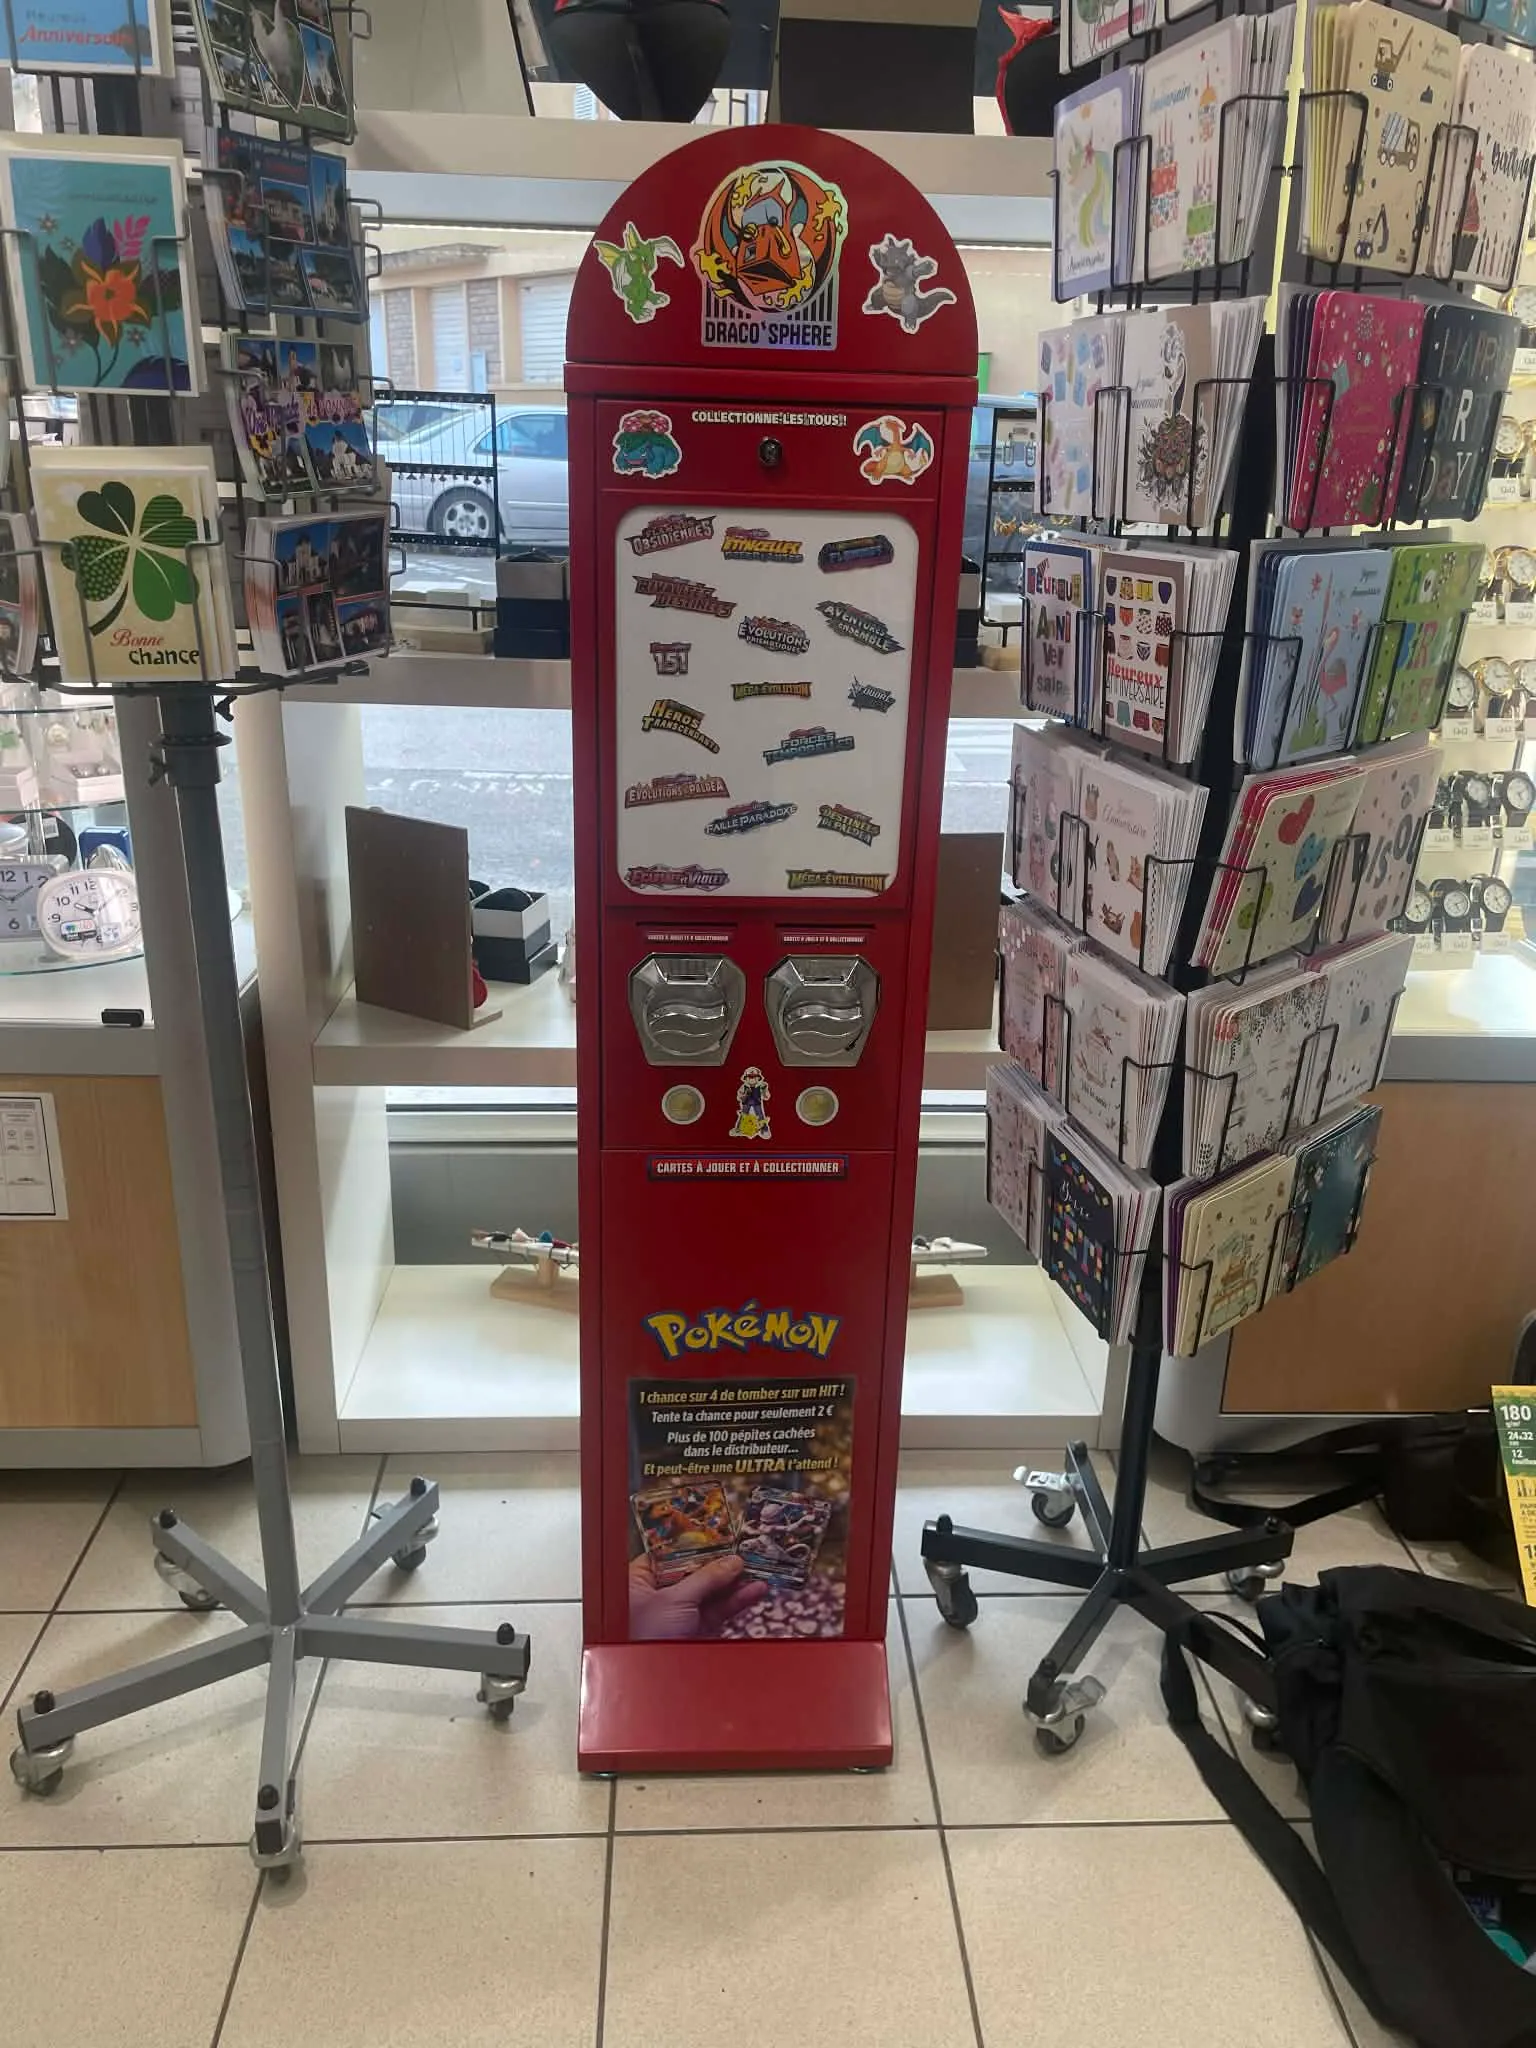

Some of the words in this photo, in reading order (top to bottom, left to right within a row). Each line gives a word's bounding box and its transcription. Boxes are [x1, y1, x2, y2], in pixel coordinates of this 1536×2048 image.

[692, 411, 804, 425] COLLECTIONNE-LES
[110, 629, 164, 647] Bonne
[129, 648, 200, 666] chance
[655, 652, 689, 675] 151
[1107, 656, 1163, 687] Heureux
[656, 1162, 693, 1173] CARTES
[696, 1159, 704, 1173] À
[705, 1162, 737, 1173] JOUER
[739, 1162, 750, 1173] ET
[753, 1159, 760, 1173] À
[763, 1162, 839, 1173] COLLECTIONNER
[647, 1390, 688, 1404] chance
[689, 1391, 707, 1402] sur
[708, 1389, 717, 1401] 4
[719, 1389, 734, 1401] de
[736, 1386, 780, 1401] tomber
[781, 1388, 800, 1400] sur
[802, 1387, 818, 1398] un
[818, 1384, 838, 1397] HIT
[652, 1411, 680, 1423] Tente
[682, 1410, 694, 1422] ta
[695, 1408, 733, 1421] chance
[733, 1408, 759, 1422] pour
[759, 1405, 817, 1420] seulement
[1500, 1404, 1532, 1421] 180
[667, 1431, 691, 1444] Plus
[692, 1430, 707, 1442] de
[709, 1429, 728, 1442] 100
[729, 1428, 772, 1443] pépites
[772, 1426, 816, 1440] cachées
[683, 1444, 710, 1456] dans
[711, 1443, 722, 1456] le
[723, 1442, 800, 1456] distributeur...
[1511, 1449, 1524, 1458] 12
[643, 1463, 655, 1475] Et
[656, 1461, 710, 1477] peut-être
[711, 1463, 734, 1474] une
[734, 1458, 785, 1473] ULTRA
[787, 1456, 833, 1471] t'attend
